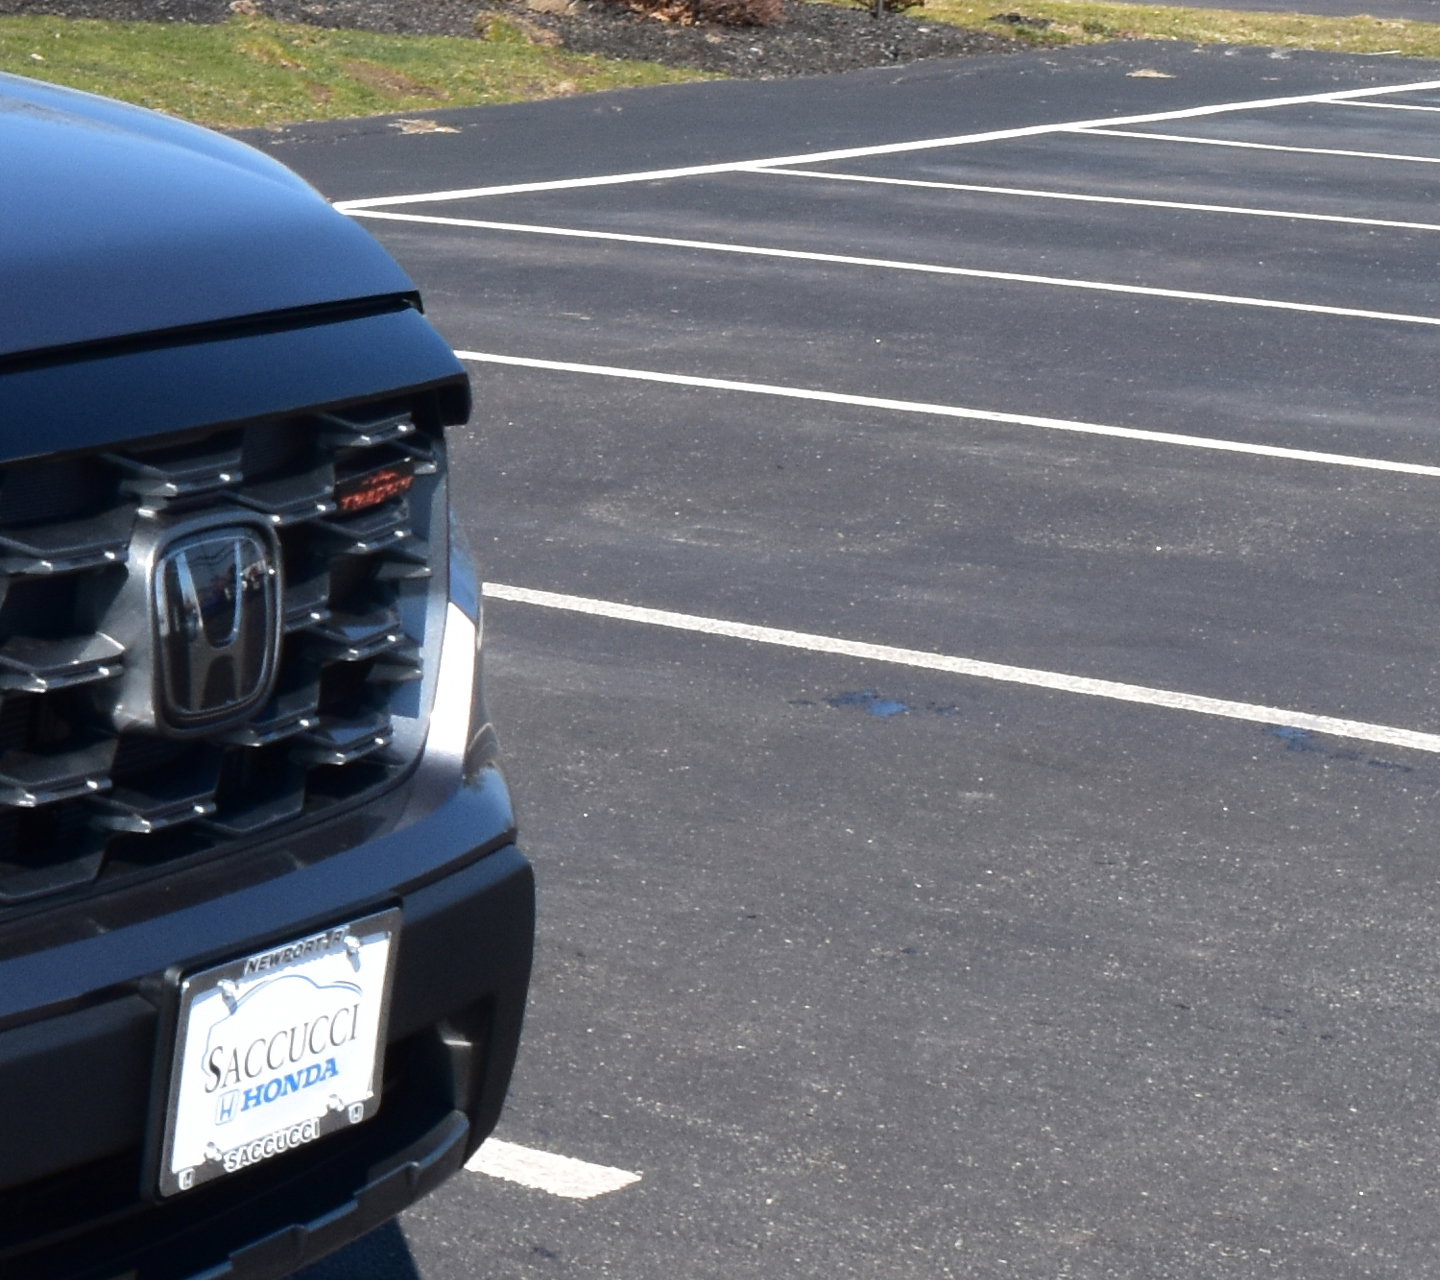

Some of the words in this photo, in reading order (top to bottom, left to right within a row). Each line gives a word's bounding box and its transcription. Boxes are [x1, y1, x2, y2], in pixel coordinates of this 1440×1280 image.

[204, 1003, 360, 1094] SACCUCCI
[240, 1057, 339, 1112] HONDA
[225, 1119, 320, 1172] SACCUCCI
